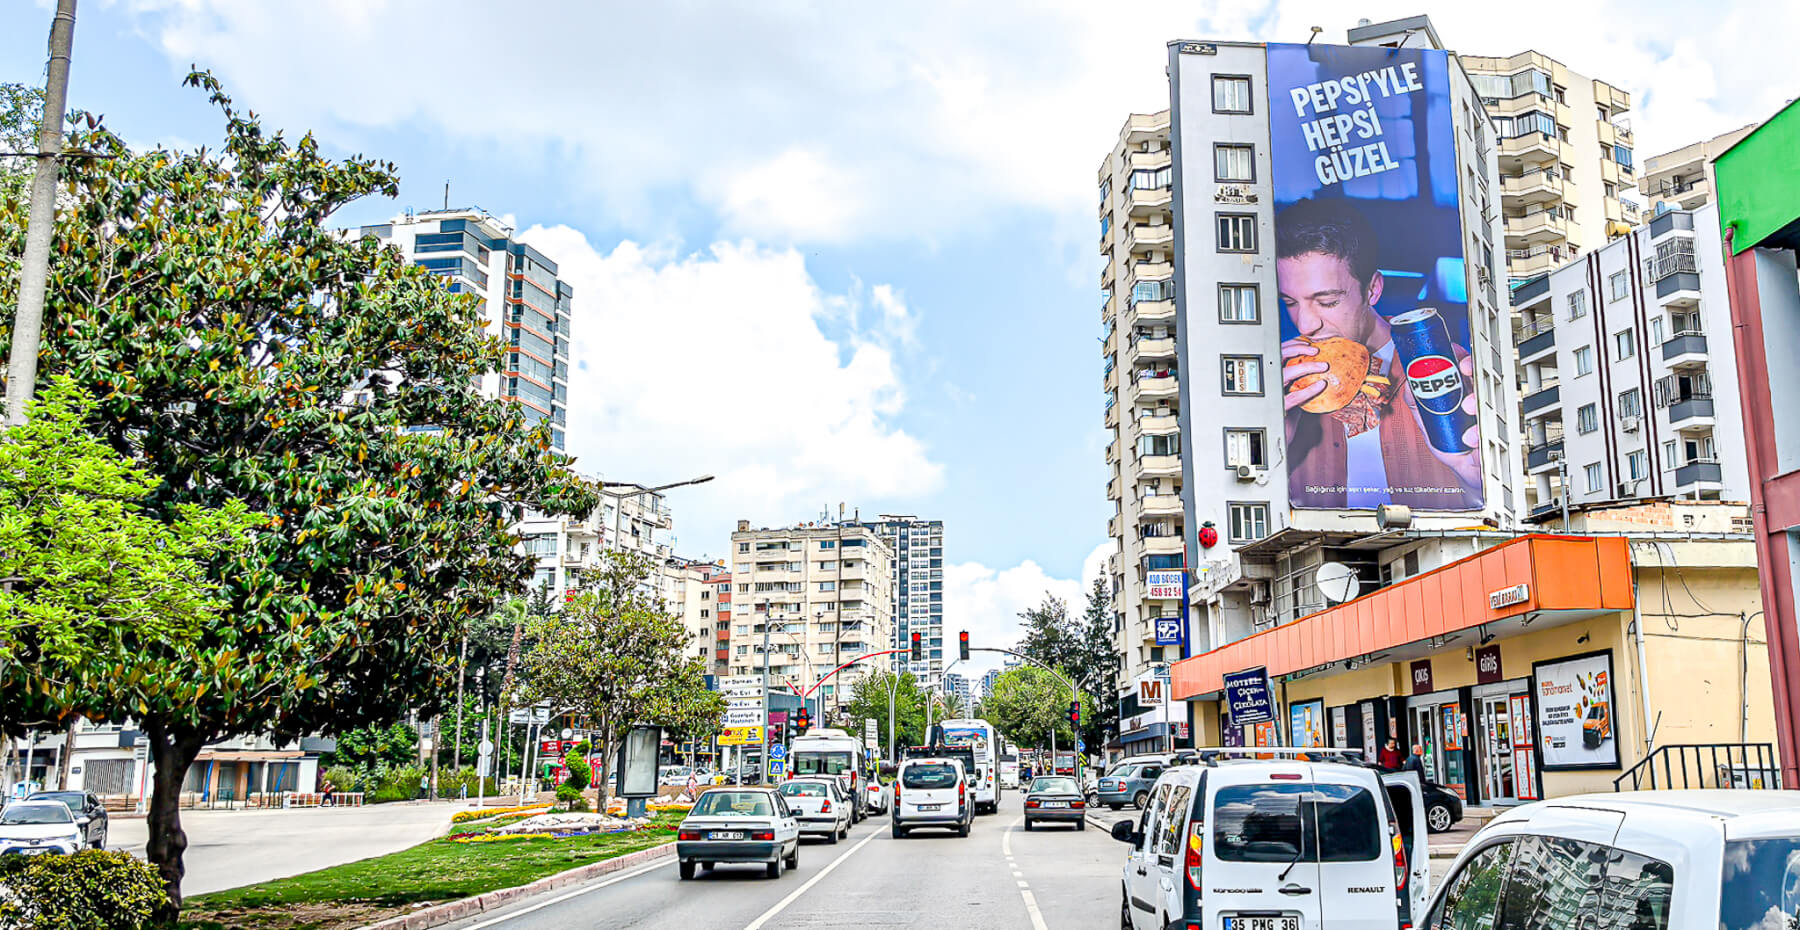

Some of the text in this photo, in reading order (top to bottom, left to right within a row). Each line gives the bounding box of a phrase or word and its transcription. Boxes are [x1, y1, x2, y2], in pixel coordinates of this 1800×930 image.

[1290, 62, 1423, 117] PEPSI'YLE
[1301, 101, 1383, 152] HEPSİ
[1315, 141, 1400, 185] GÜZEL
[1410, 372, 1460, 392] PEPSI
[1480, 652, 1498, 674] GİRİŞ
[1141, 681, 1161, 698] M
[1347, 885, 1384, 894] RENAULT
[1231, 919, 1245, 930] 35
[1281, 919, 1296, 930] 36
